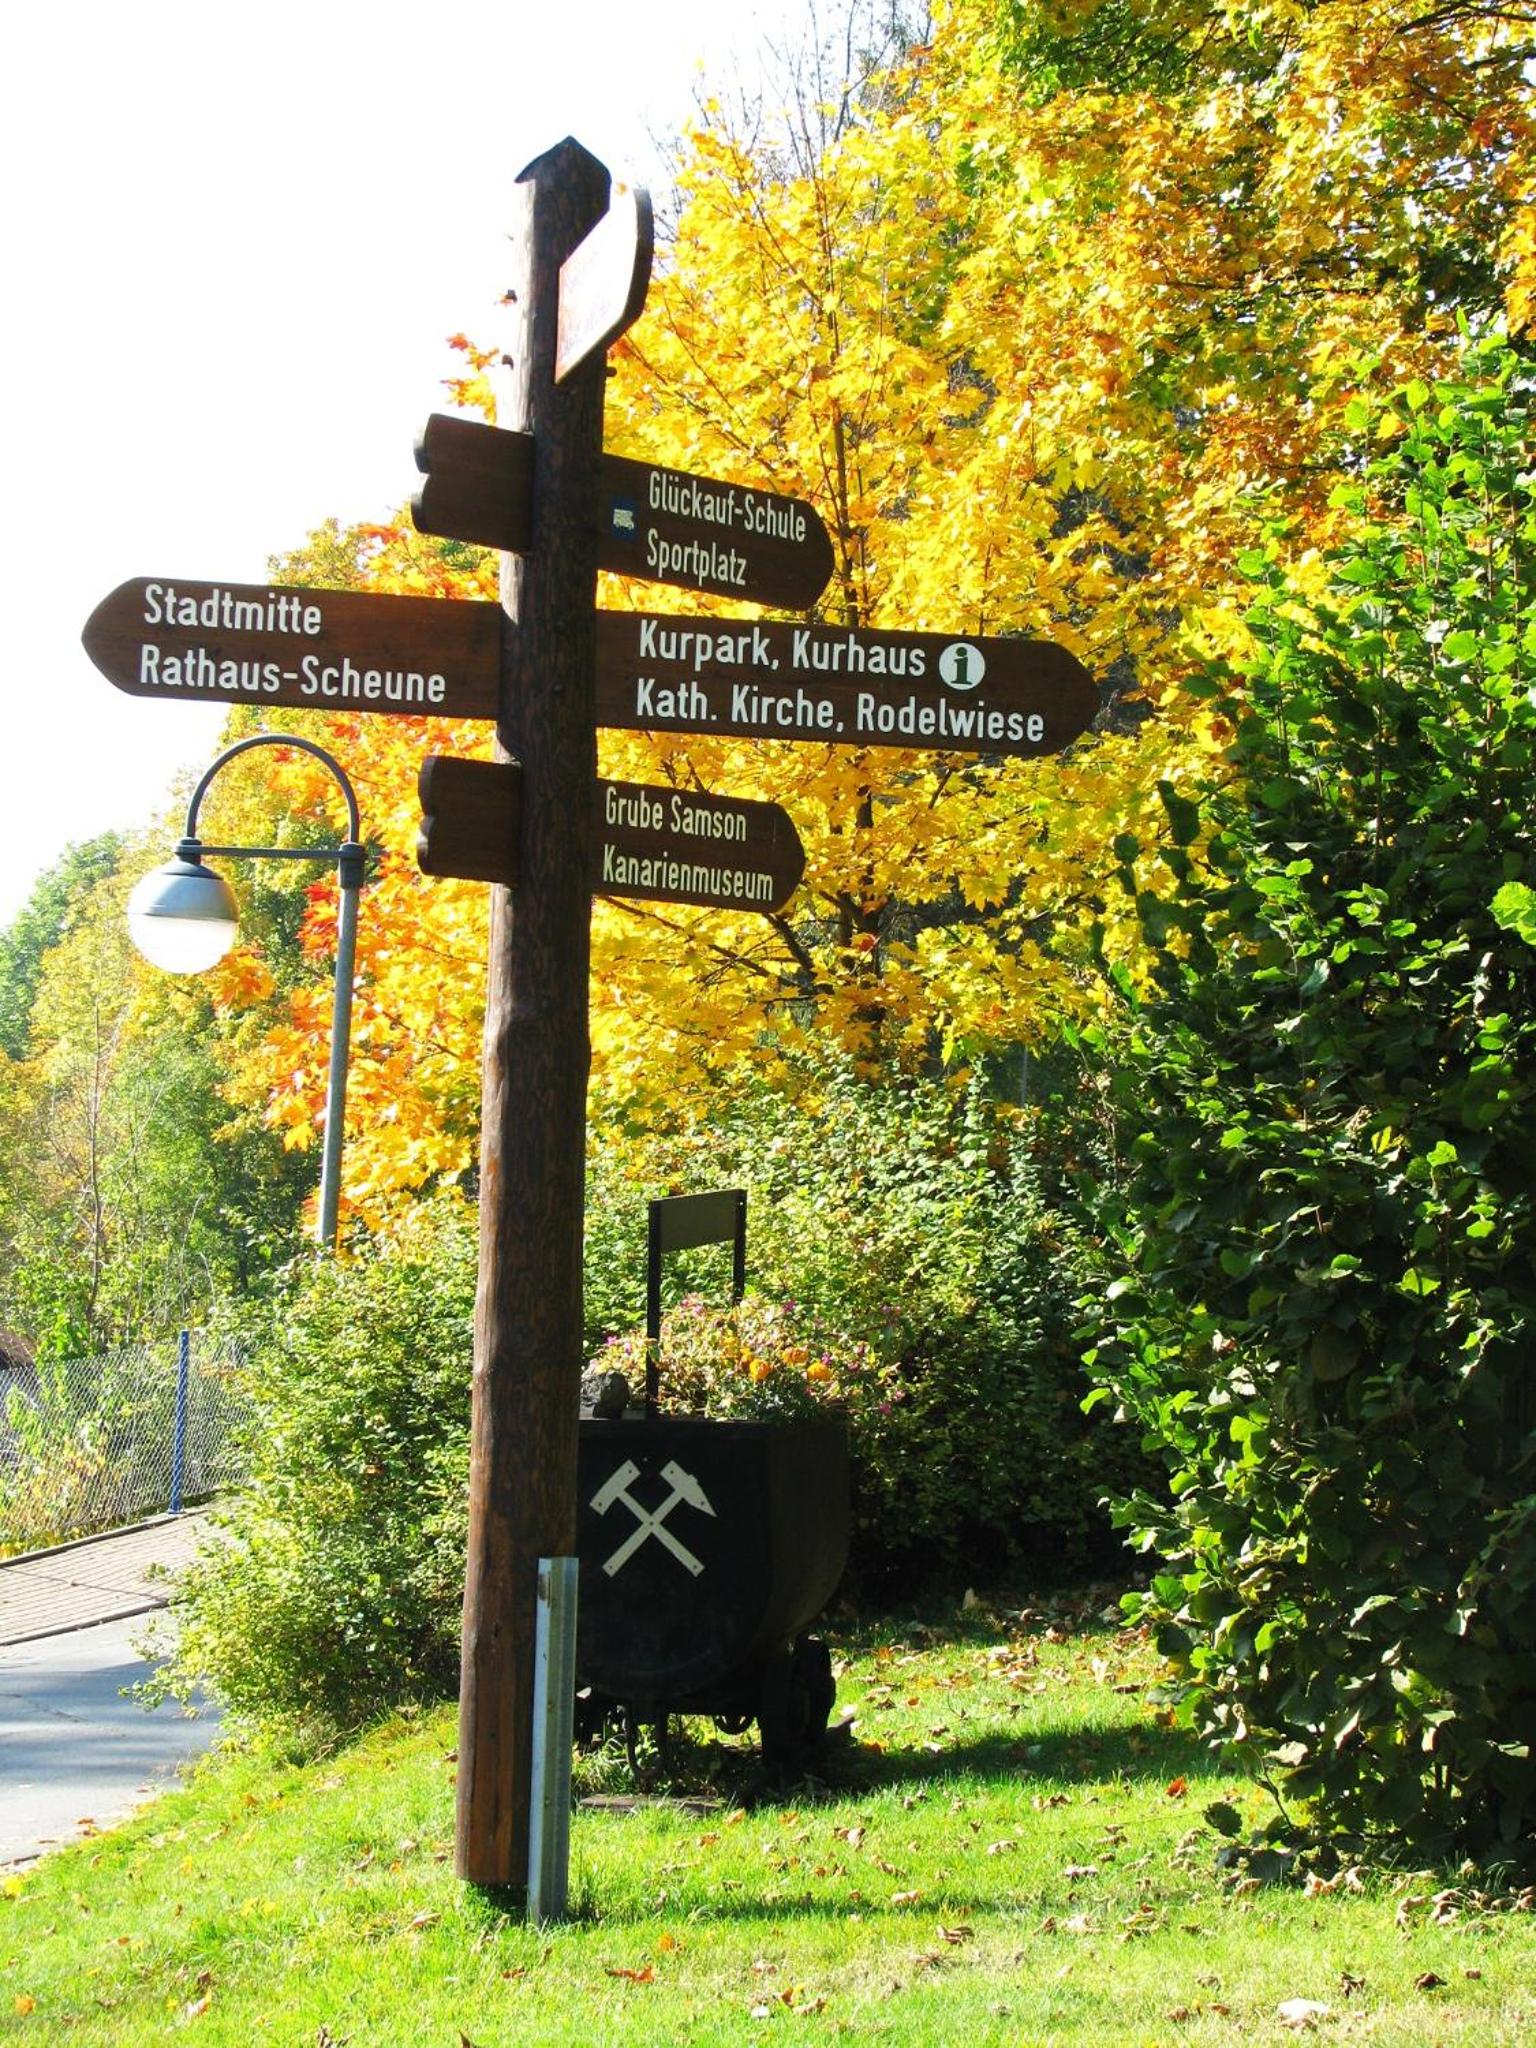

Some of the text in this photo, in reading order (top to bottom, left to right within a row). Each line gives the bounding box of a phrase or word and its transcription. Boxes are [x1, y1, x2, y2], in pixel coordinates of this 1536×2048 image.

[649, 470, 806, 542] Glückauf-Schule
[647, 527, 747, 586] Sportplatz
[144, 583, 322, 634] Stadtmitte
[140, 644, 446, 703] Rathaus-Scheune
[638, 618, 779, 671] Kurpark,
[792, 630, 926, 676] Kurhaus
[636, 677, 1044, 742] Kath. Kirche, Rodelwiese
[605, 785, 747, 842] Grube Samson
[602, 843, 773, 902] Kanarienmuseum
